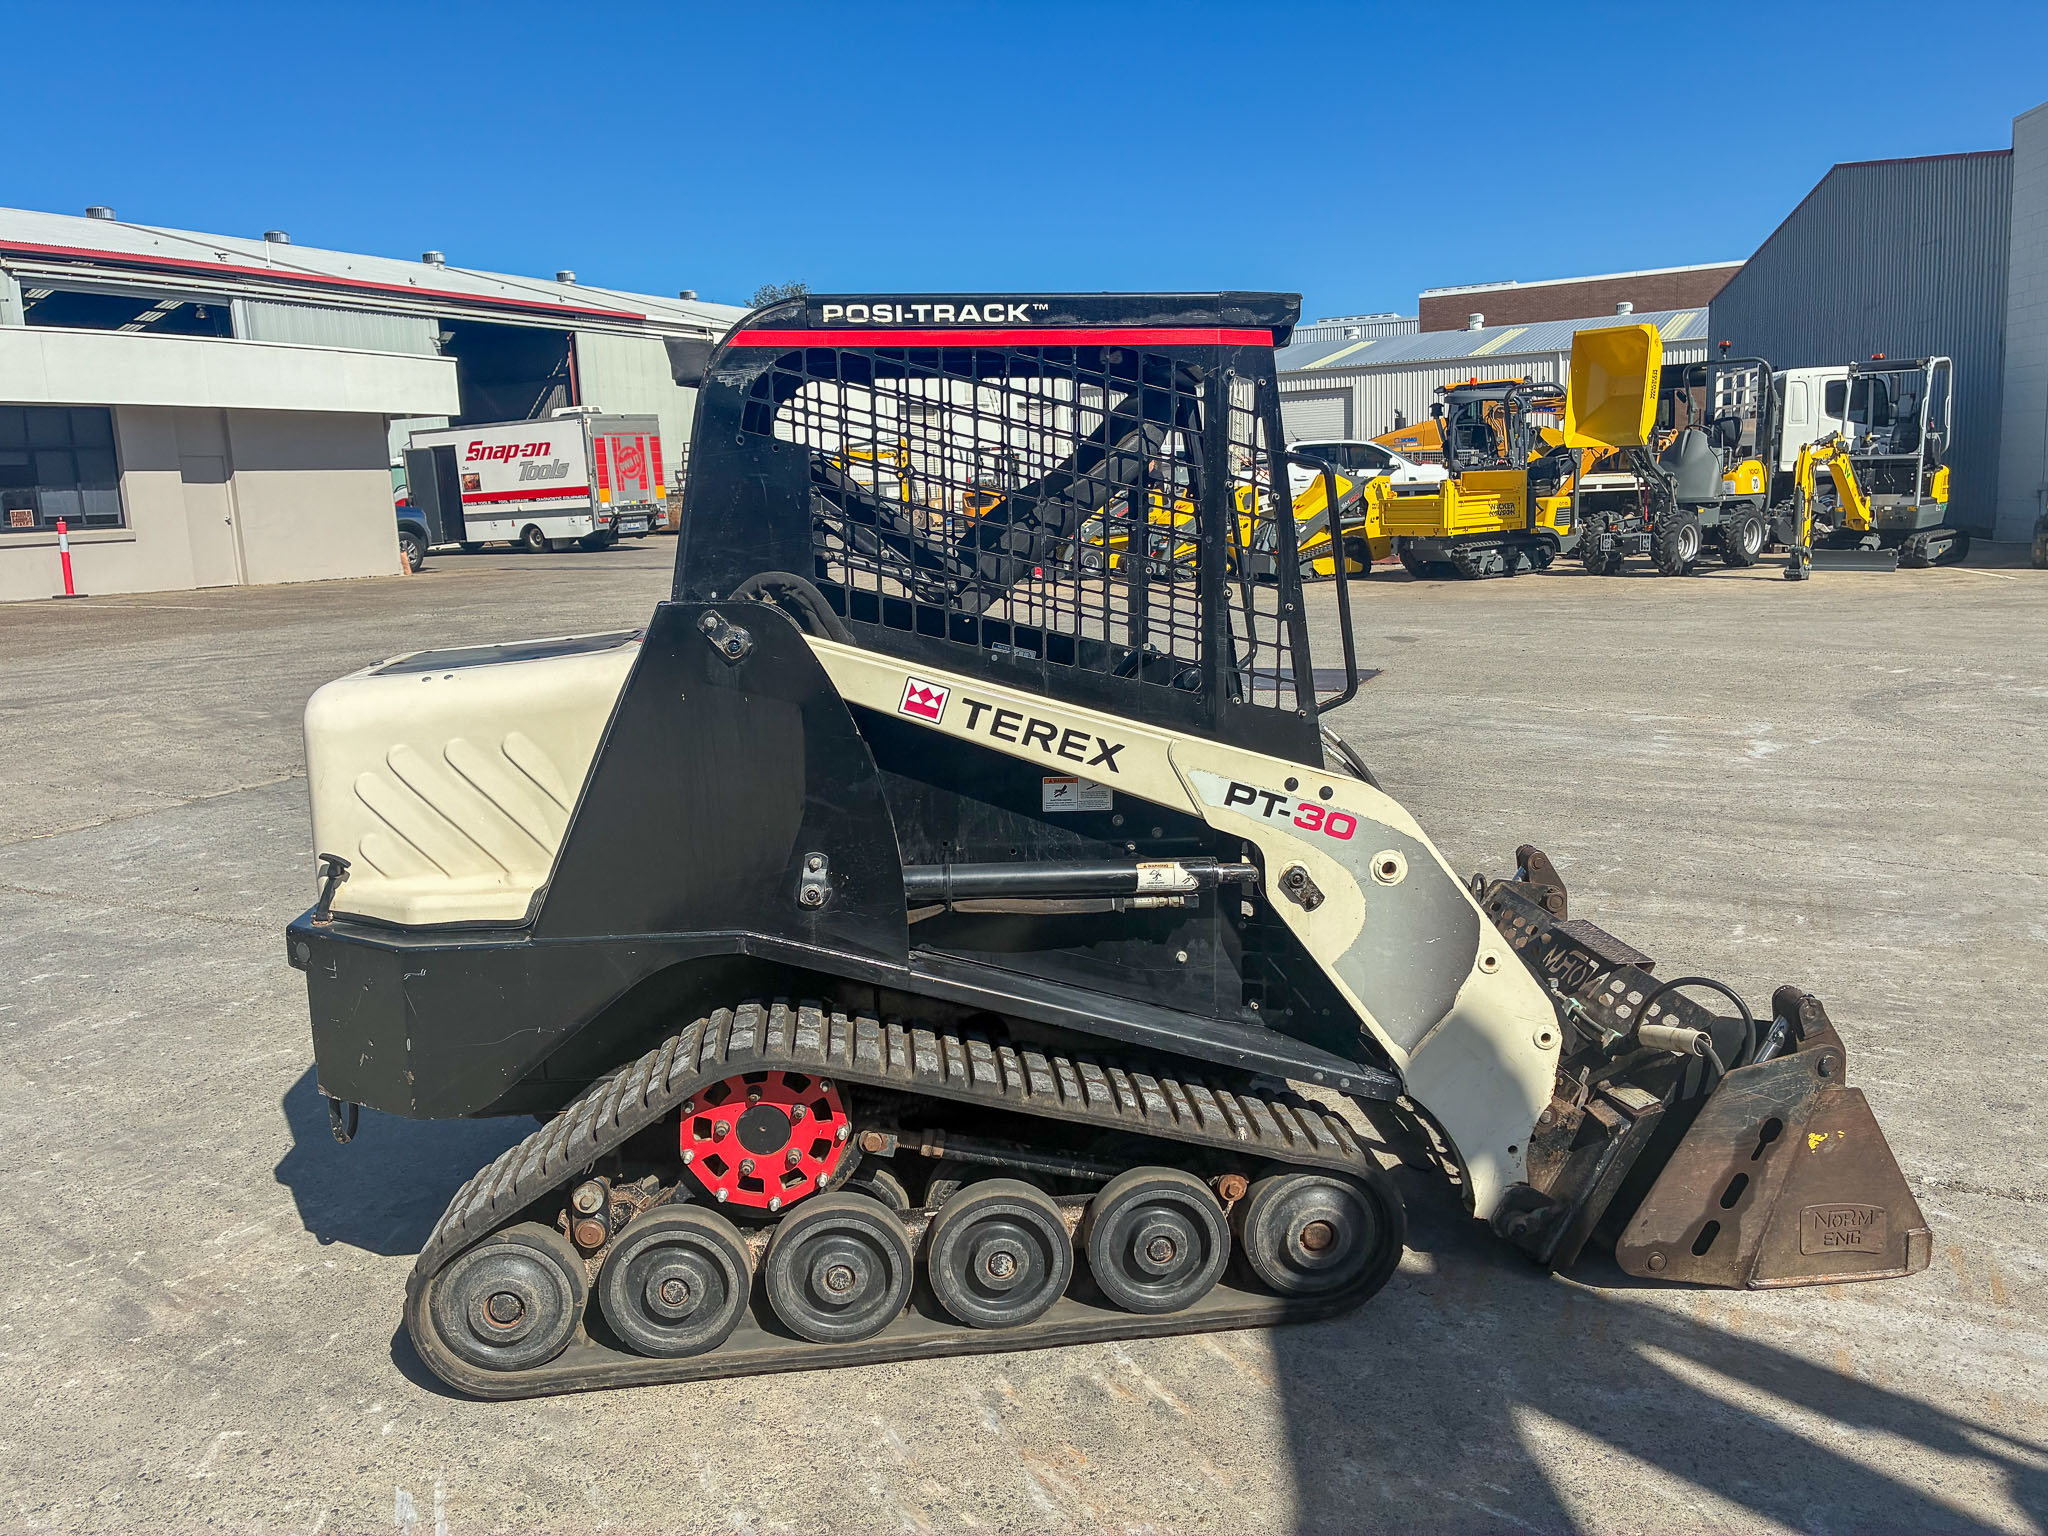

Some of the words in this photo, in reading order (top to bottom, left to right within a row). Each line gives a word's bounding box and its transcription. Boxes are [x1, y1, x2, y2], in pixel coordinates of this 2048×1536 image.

[466, 440, 551, 463] Snap-on
[519, 459, 571, 482] Tools
[962, 697, 1126, 774] TEREX
[1224, 781, 1358, 841] PT-30
[1814, 1209, 1874, 1230] NORM
[1823, 1230, 1861, 1246] ENG
